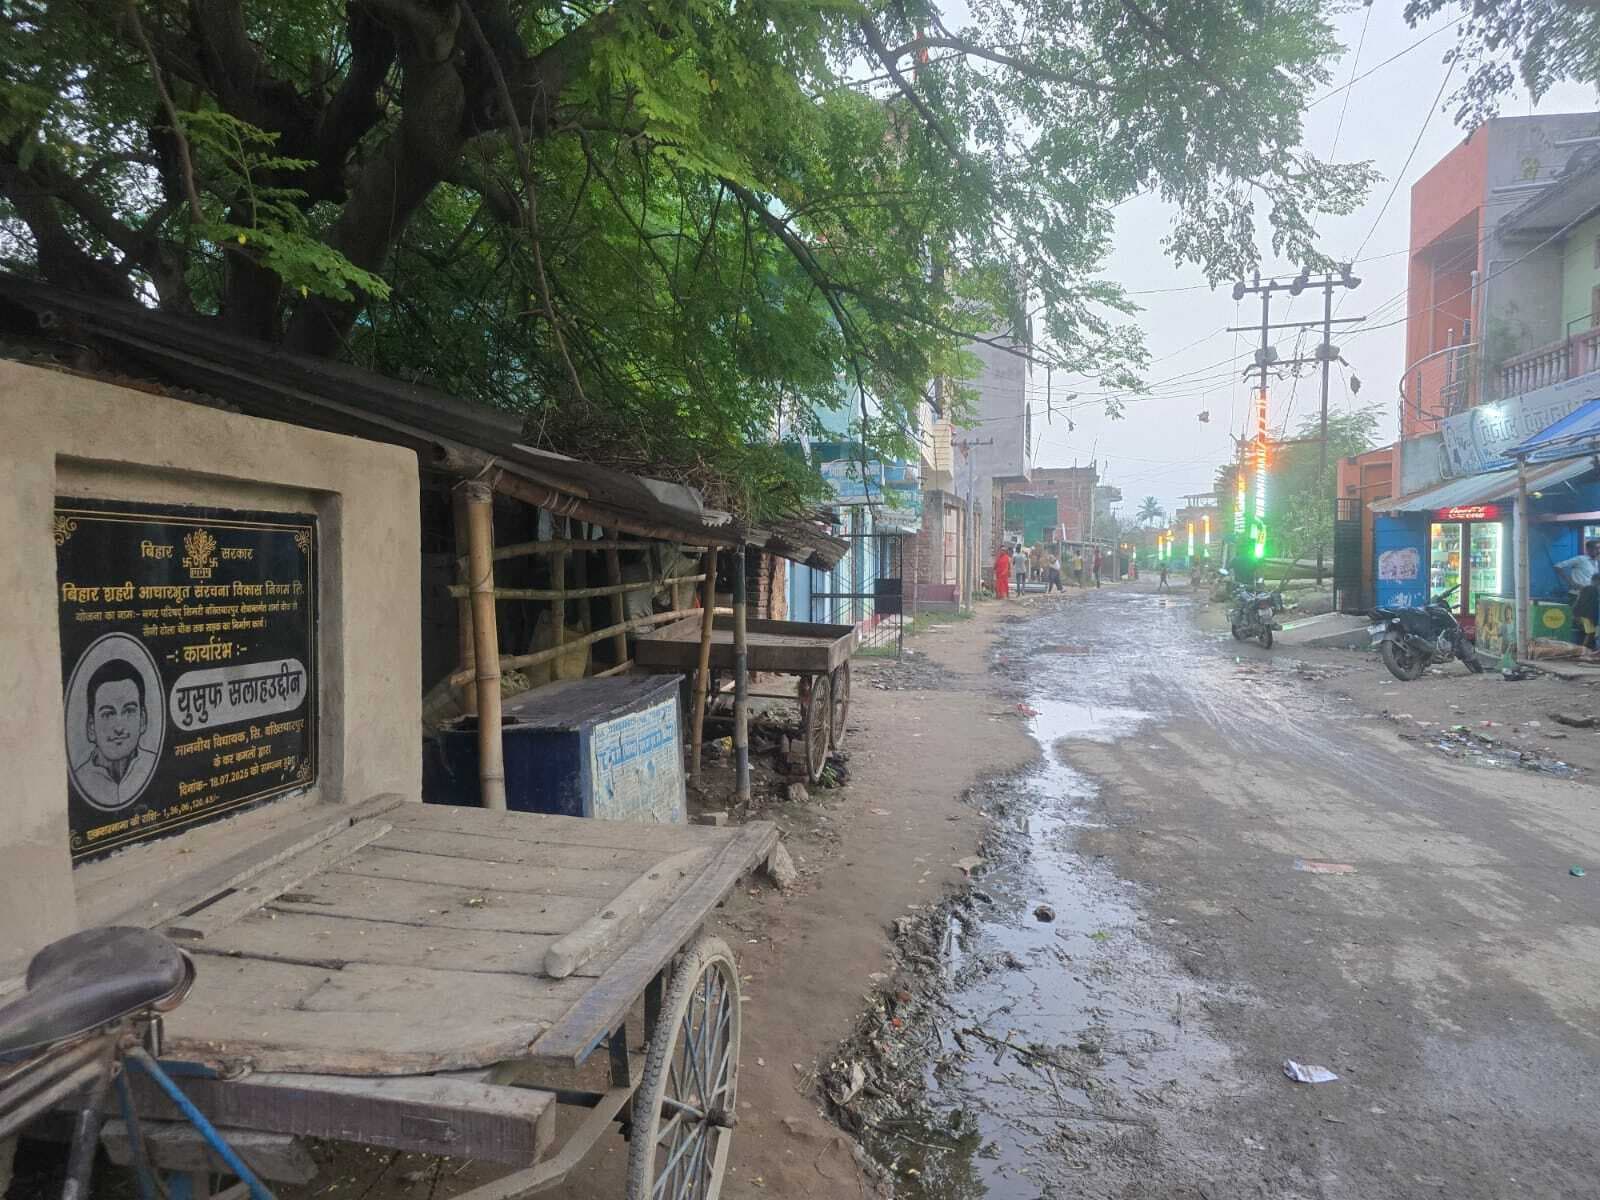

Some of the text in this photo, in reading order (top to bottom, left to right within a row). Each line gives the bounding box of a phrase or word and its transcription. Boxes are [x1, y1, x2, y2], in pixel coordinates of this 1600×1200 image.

[141, 540, 254, 560] बिहार सरकार
[62, 582, 100, 602] बिहार
[103, 580, 135, 602] शहरी
[194, 580, 228, 600] संरचना
[233, 580, 263, 597] विकास
[265, 580, 290, 596] निगम
[183, 635, 233, 663] कार्यारंभ
[176, 683, 223, 727] युसुफ
[174, 736, 211, 757] माननीय
[212, 753, 221, 768] के
[222, 754, 234, 765] कर
[249, 763, 259, 777] को
